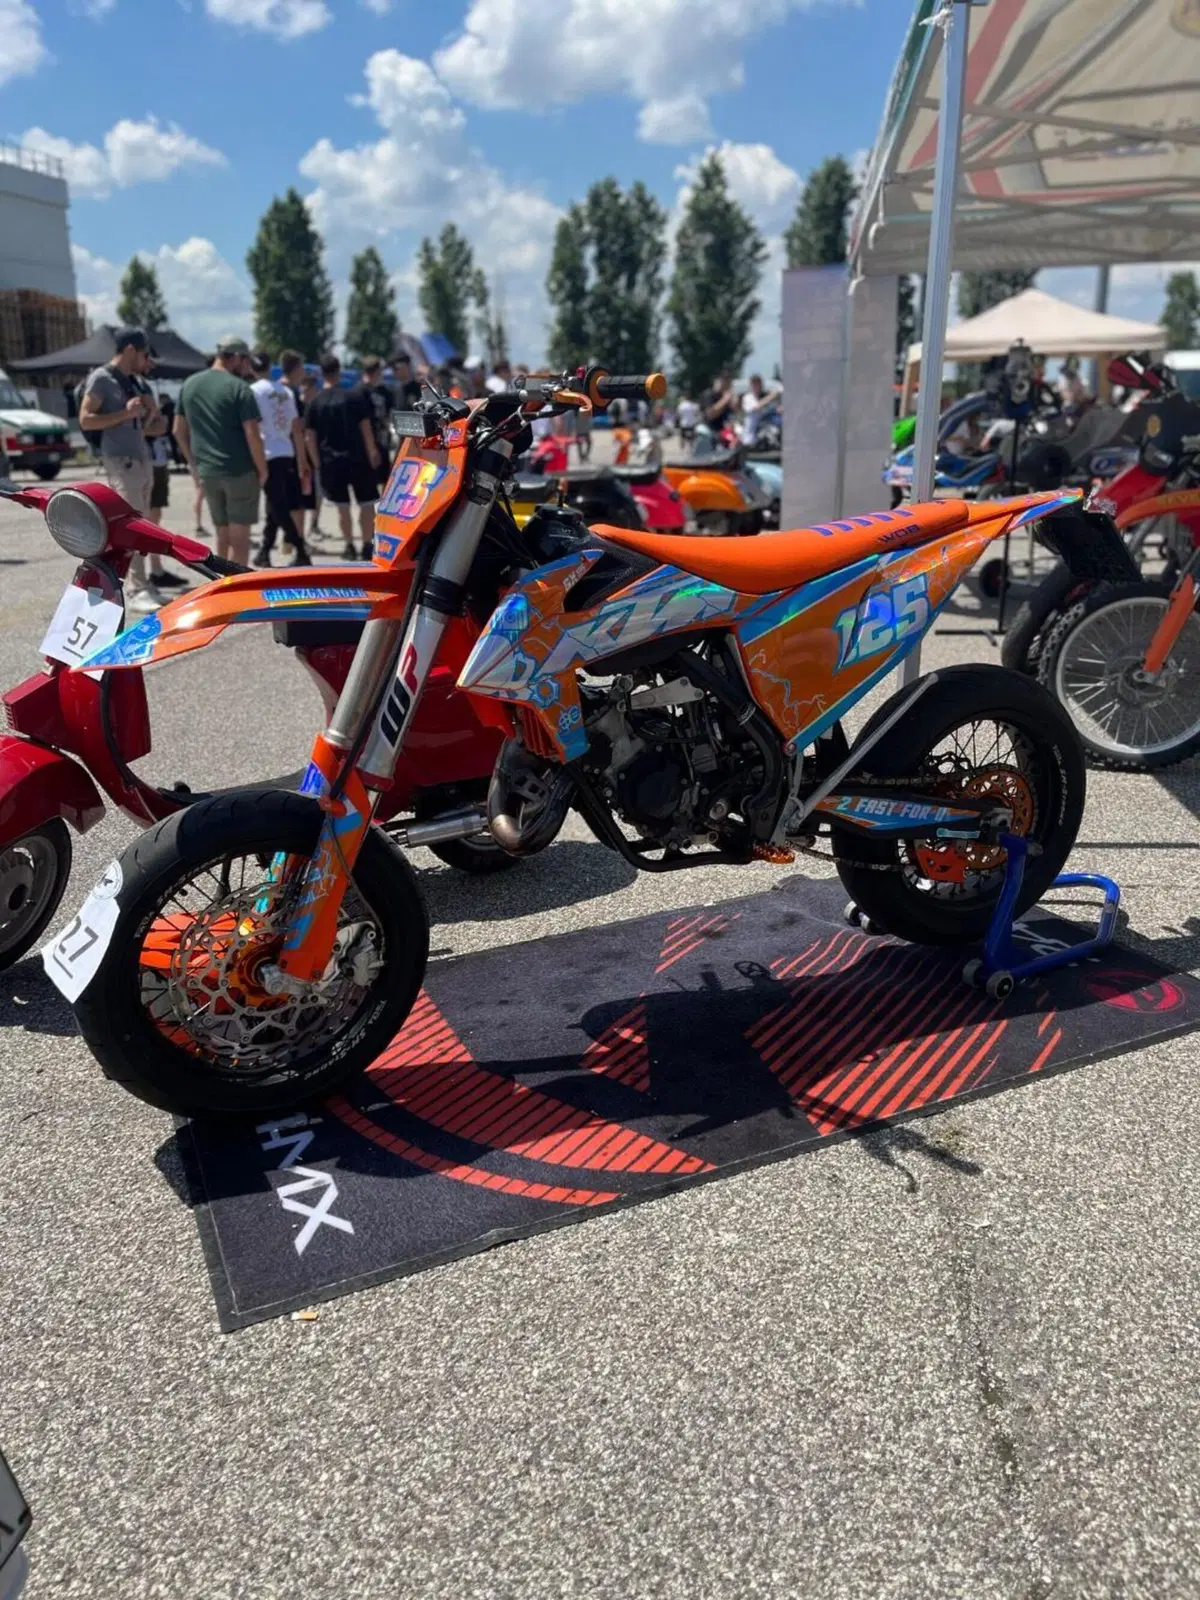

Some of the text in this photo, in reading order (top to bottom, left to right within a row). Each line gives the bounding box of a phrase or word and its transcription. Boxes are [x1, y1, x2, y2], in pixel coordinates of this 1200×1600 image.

[67, 616, 99, 651] 57
[833, 573, 930, 674] 125
[379, 641, 419, 748] WP
[836, 795, 850, 811] 2
[854, 797, 898, 817] FAST
[900, 803, 934, 821] FOR
[59, 915, 99, 963] 27
